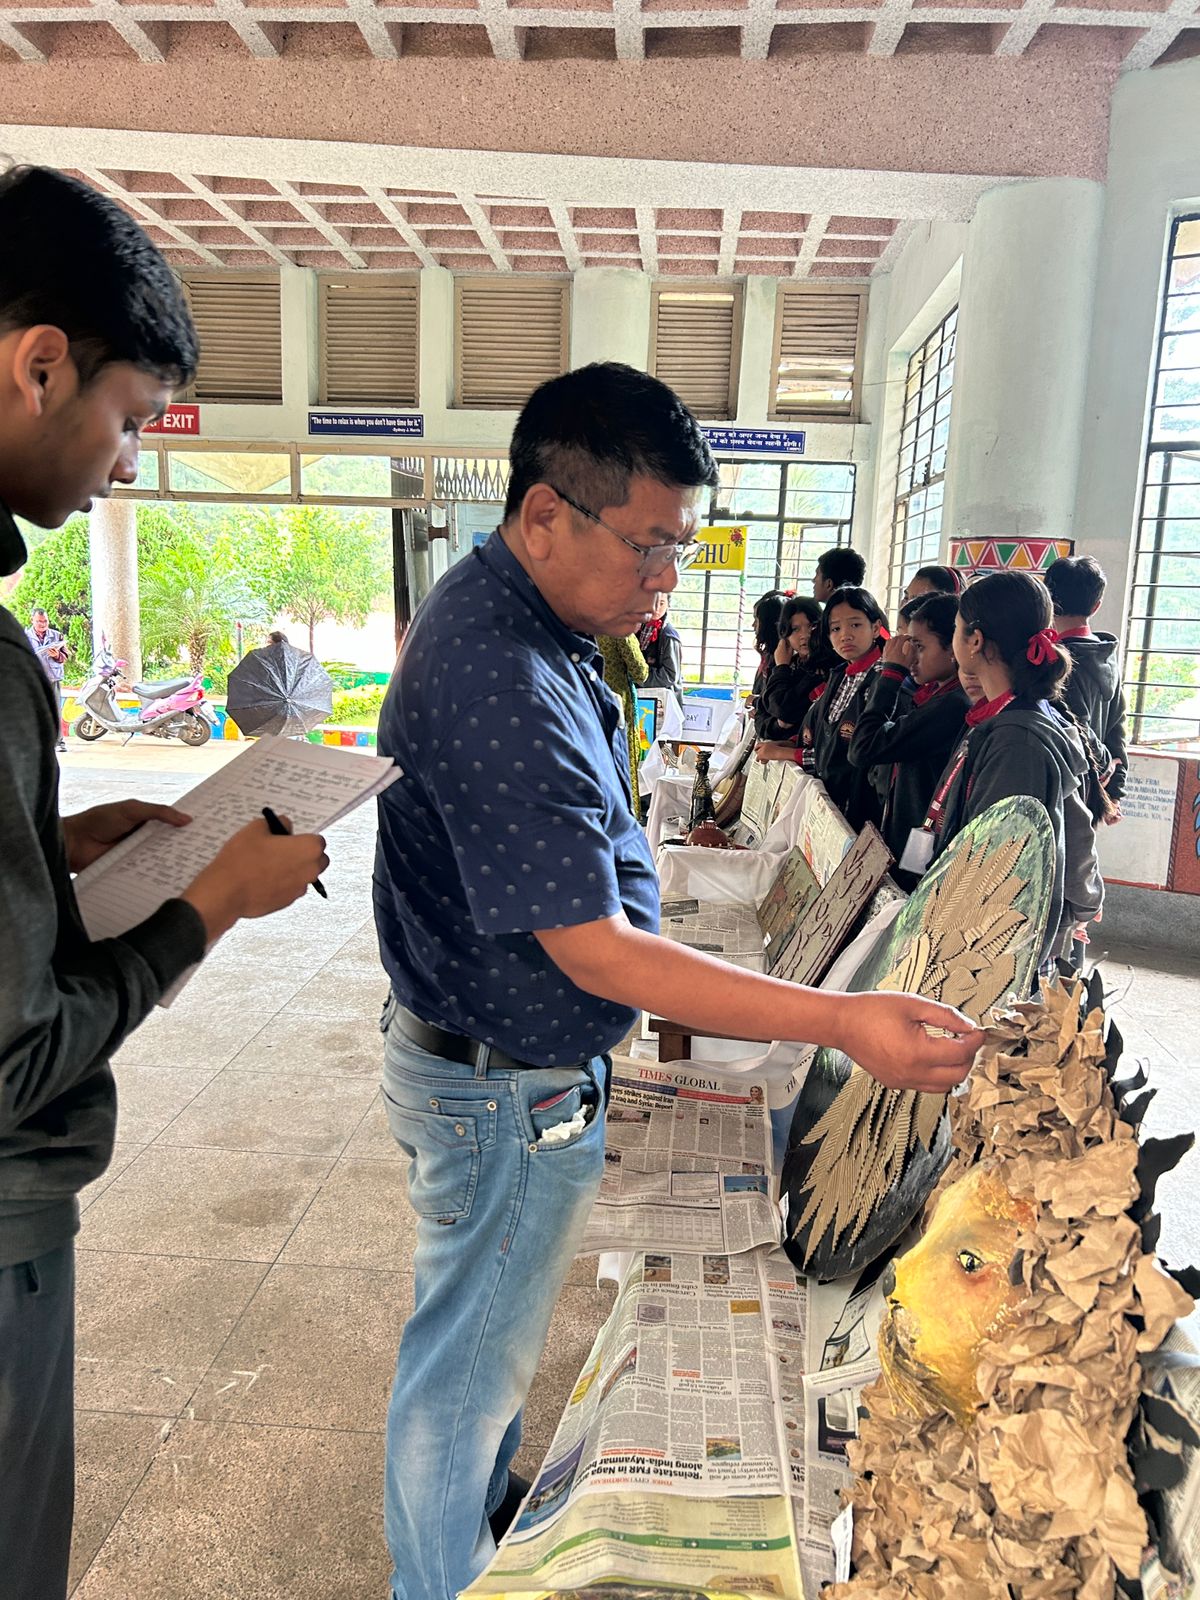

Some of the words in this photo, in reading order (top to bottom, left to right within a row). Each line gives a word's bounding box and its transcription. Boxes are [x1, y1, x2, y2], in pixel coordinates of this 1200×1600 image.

[163, 414, 194, 428] EXIT
[322, 417, 332, 425] time
[366, 419, 375, 427] you
[638, 1068, 672, 1083] TIMES
[674, 1074, 720, 1091] GLOBAL
[616, 1095, 627, 1103] Iraq
[624, 1089, 642, 1098] strikes
[642, 1093, 663, 1102] against
[663, 1096, 674, 1104] Iran
[599, 1456, 673, 1470] India-Myanmar
[675, 1461, 703, 1471] along
[591, 1466, 616, 1476] Naga
[618, 1466, 627, 1475] in
[629, 1466, 651, 1475] FMR
